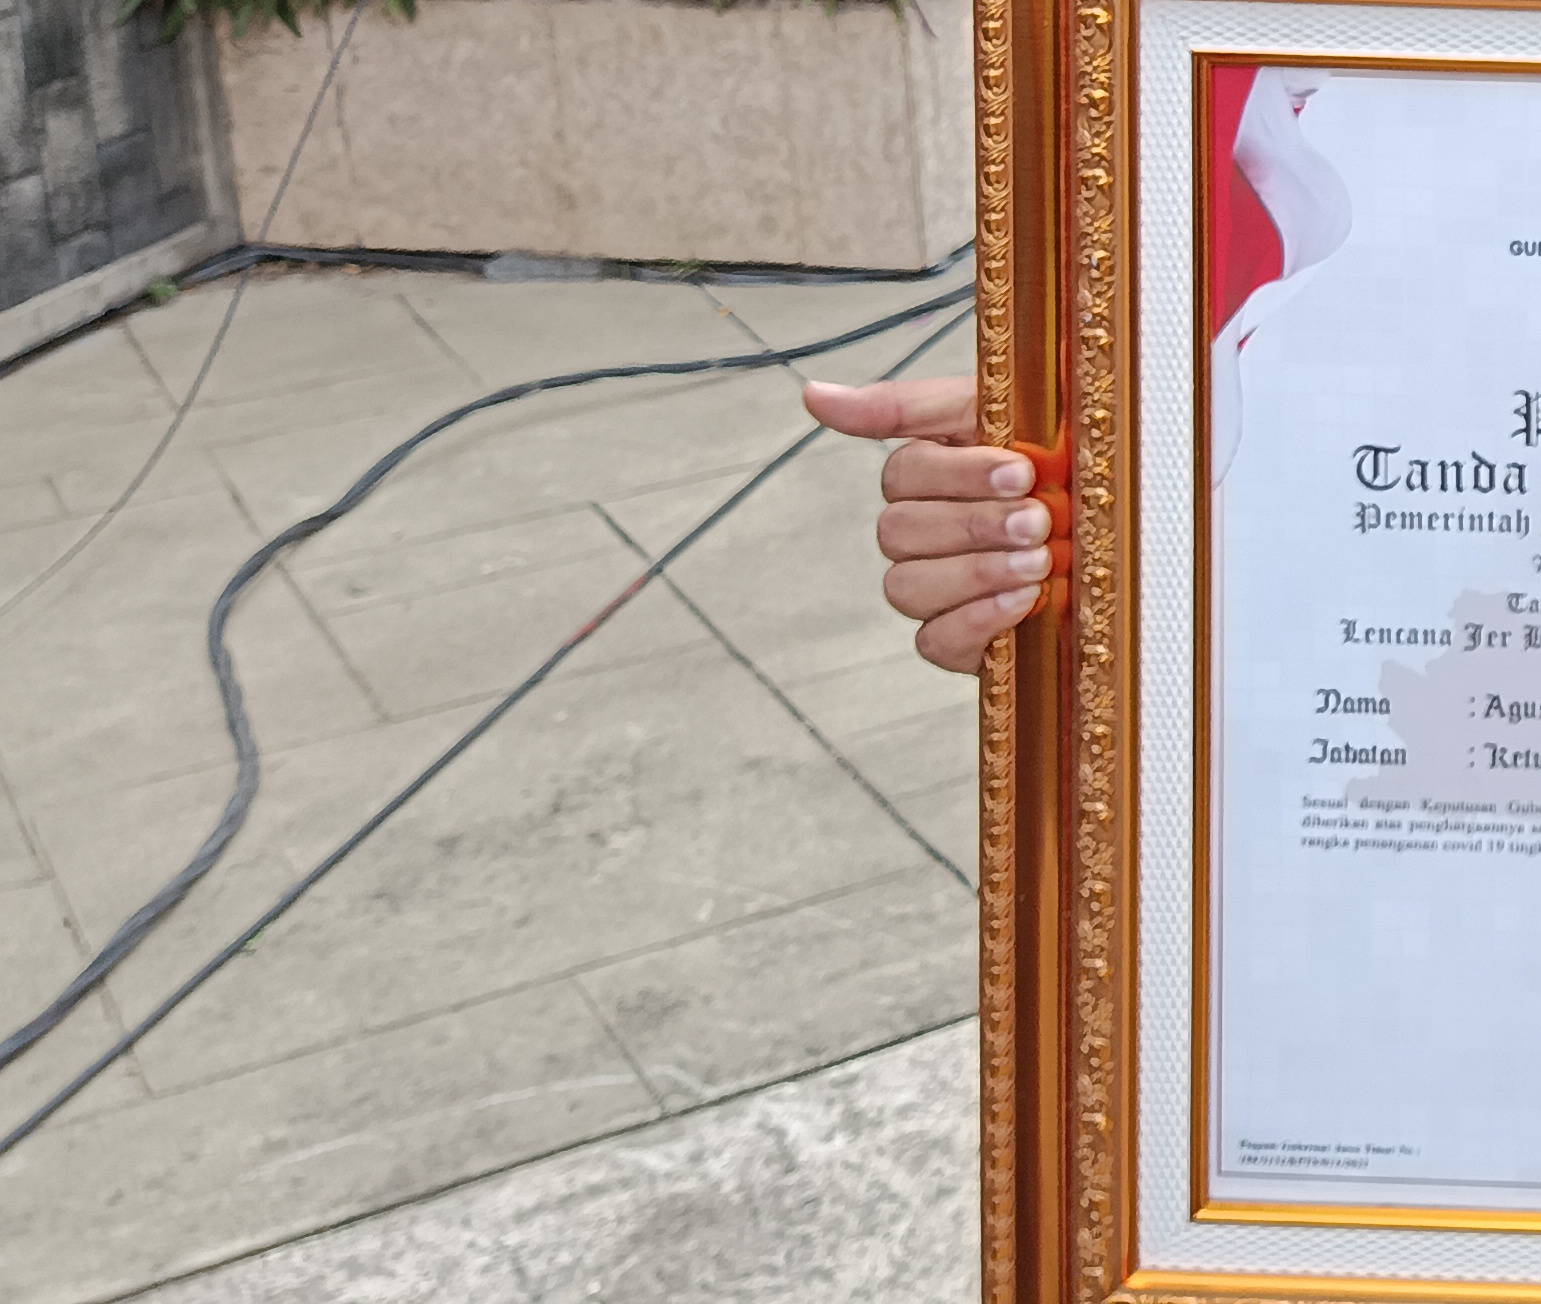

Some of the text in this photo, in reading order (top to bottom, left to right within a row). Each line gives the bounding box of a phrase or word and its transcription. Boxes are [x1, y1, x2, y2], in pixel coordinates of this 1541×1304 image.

[1353, 444, 1528, 494] Tanda
[1353, 501, 1531, 540] Pemerintah
[1340, 618, 1452, 646] Lencana
[1463, 622, 1512, 651] Jer
[1315, 688, 1391, 715] Nama
[1307, 738, 1407, 766] Jabatan
